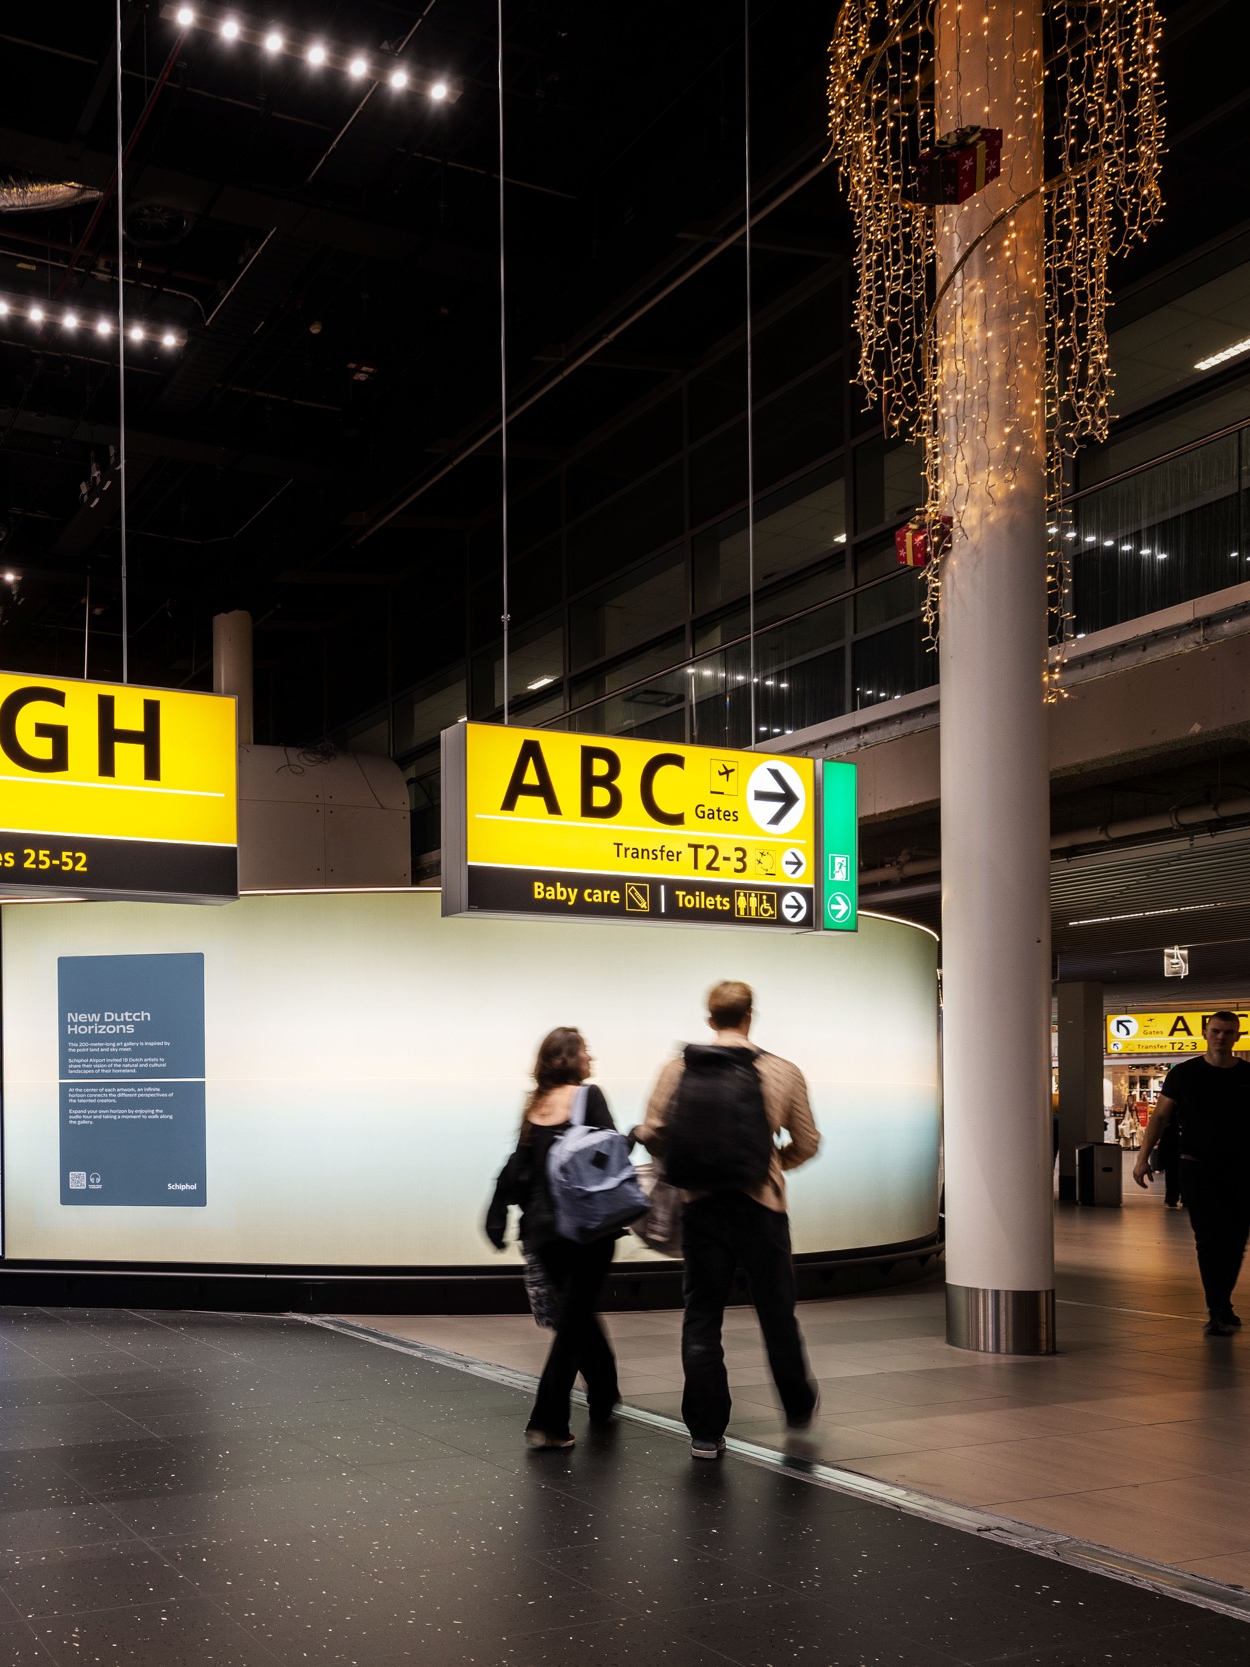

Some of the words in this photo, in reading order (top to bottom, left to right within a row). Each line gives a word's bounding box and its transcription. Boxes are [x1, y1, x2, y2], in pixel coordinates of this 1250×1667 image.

[694, 804, 739, 823] Gates
[23, 848, 88, 872] 25-52
[613, 842, 683, 863] Transfer
[688, 843, 747, 873] T2-3
[534, 881, 580, 906] Baby
[583, 887, 620, 905] care
[675, 890, 731, 911] Toilets
[67, 1012, 100, 1023] New
[104, 1011, 151, 1022] Dutch
[67, 1024, 135, 1035] Horizons
[1169, 1042, 1197, 1050] T2-3
[167, 1183, 197, 1192] Schiphol
